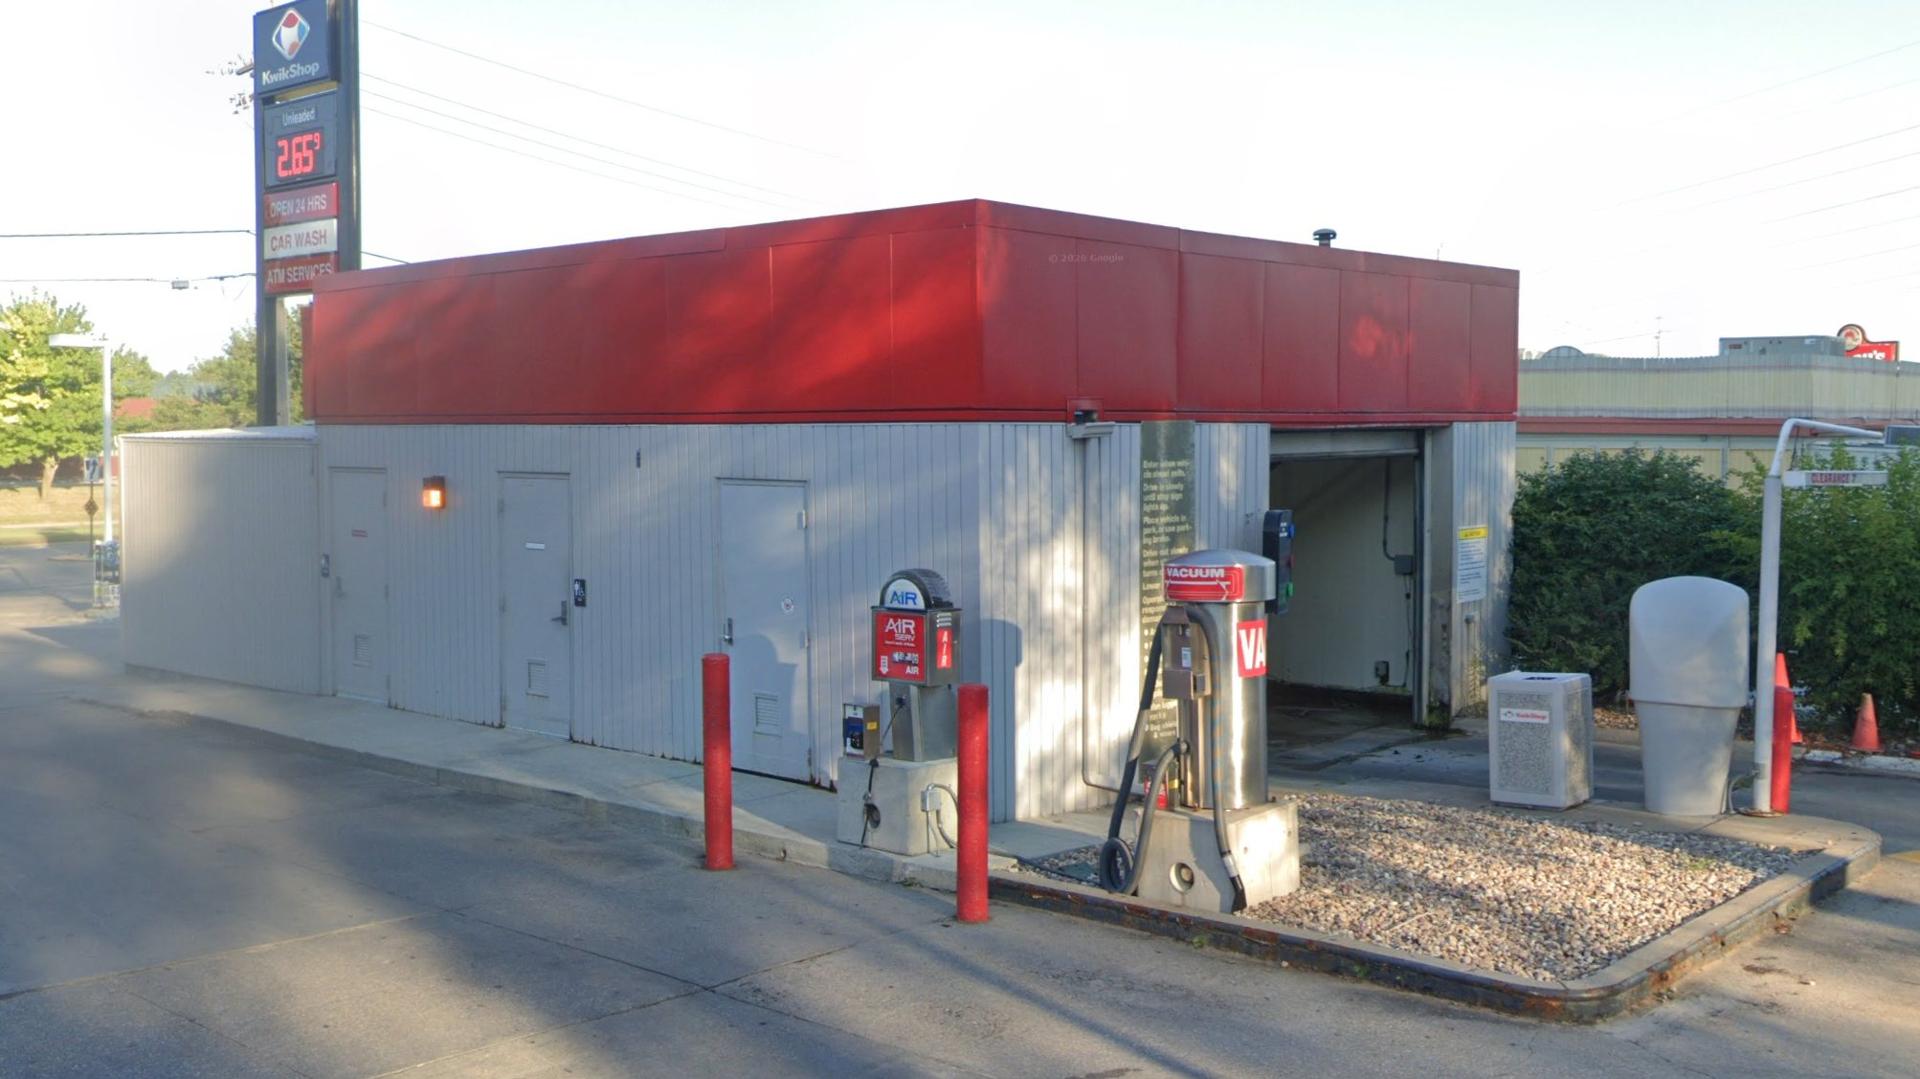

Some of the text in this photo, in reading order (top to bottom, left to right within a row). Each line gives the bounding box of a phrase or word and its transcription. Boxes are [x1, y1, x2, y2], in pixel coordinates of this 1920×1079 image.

[262, 62, 320, 85] KwikShop
[282, 108, 316, 126] Unleaded
[271, 194, 328, 217] OPEN 24 HRS
[270, 229, 328, 252] CAR WASH
[267, 263, 333, 284] ATM SERVICES
[1167, 567, 1225, 578] VACUUM
[889, 591, 917, 606] AIR
[884, 618, 916, 635] AIR
[905, 665, 919, 675] AIR
